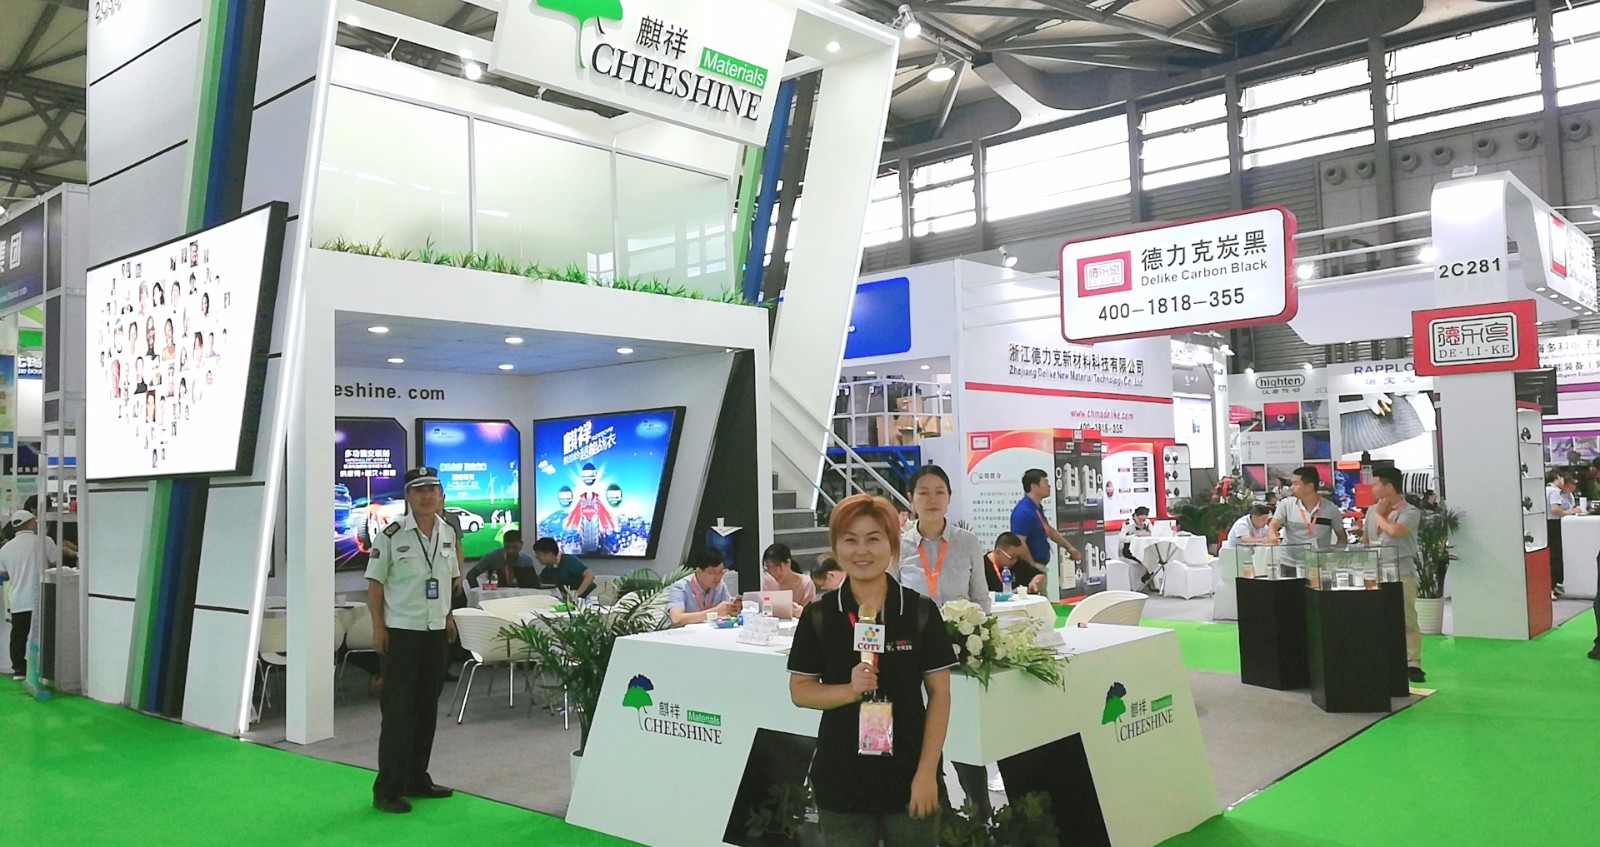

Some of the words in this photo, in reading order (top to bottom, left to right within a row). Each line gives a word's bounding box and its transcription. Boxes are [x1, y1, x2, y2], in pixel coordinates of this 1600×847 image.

[636, 15, 688, 60] 麒祥
[591, 43, 762, 121] CHEESHINE
[703, 51, 765, 87] Materials
[1141, 229, 1267, 272] 德力克炭黑
[1141, 273, 1178, 286] Delike
[1181, 266, 1227, 280] Carbon
[1231, 258, 1268, 273] Black
[1439, 257, 1501, 279] 2C281
[1008, 343, 1144, 376] 浙江德力克新材料科技有限公司
[1009, 366, 1037, 379] Zhejiang
[1260, 377, 1301, 390] highten
[1070, 409, 1134, 421] www.chinadelike.com
[857, 642, 881, 651] COTV
[659, 701, 680, 719] 麒祥
[644, 717, 723, 745] CHEESHINE
[1120, 708, 1174, 741] CHEESHINE
